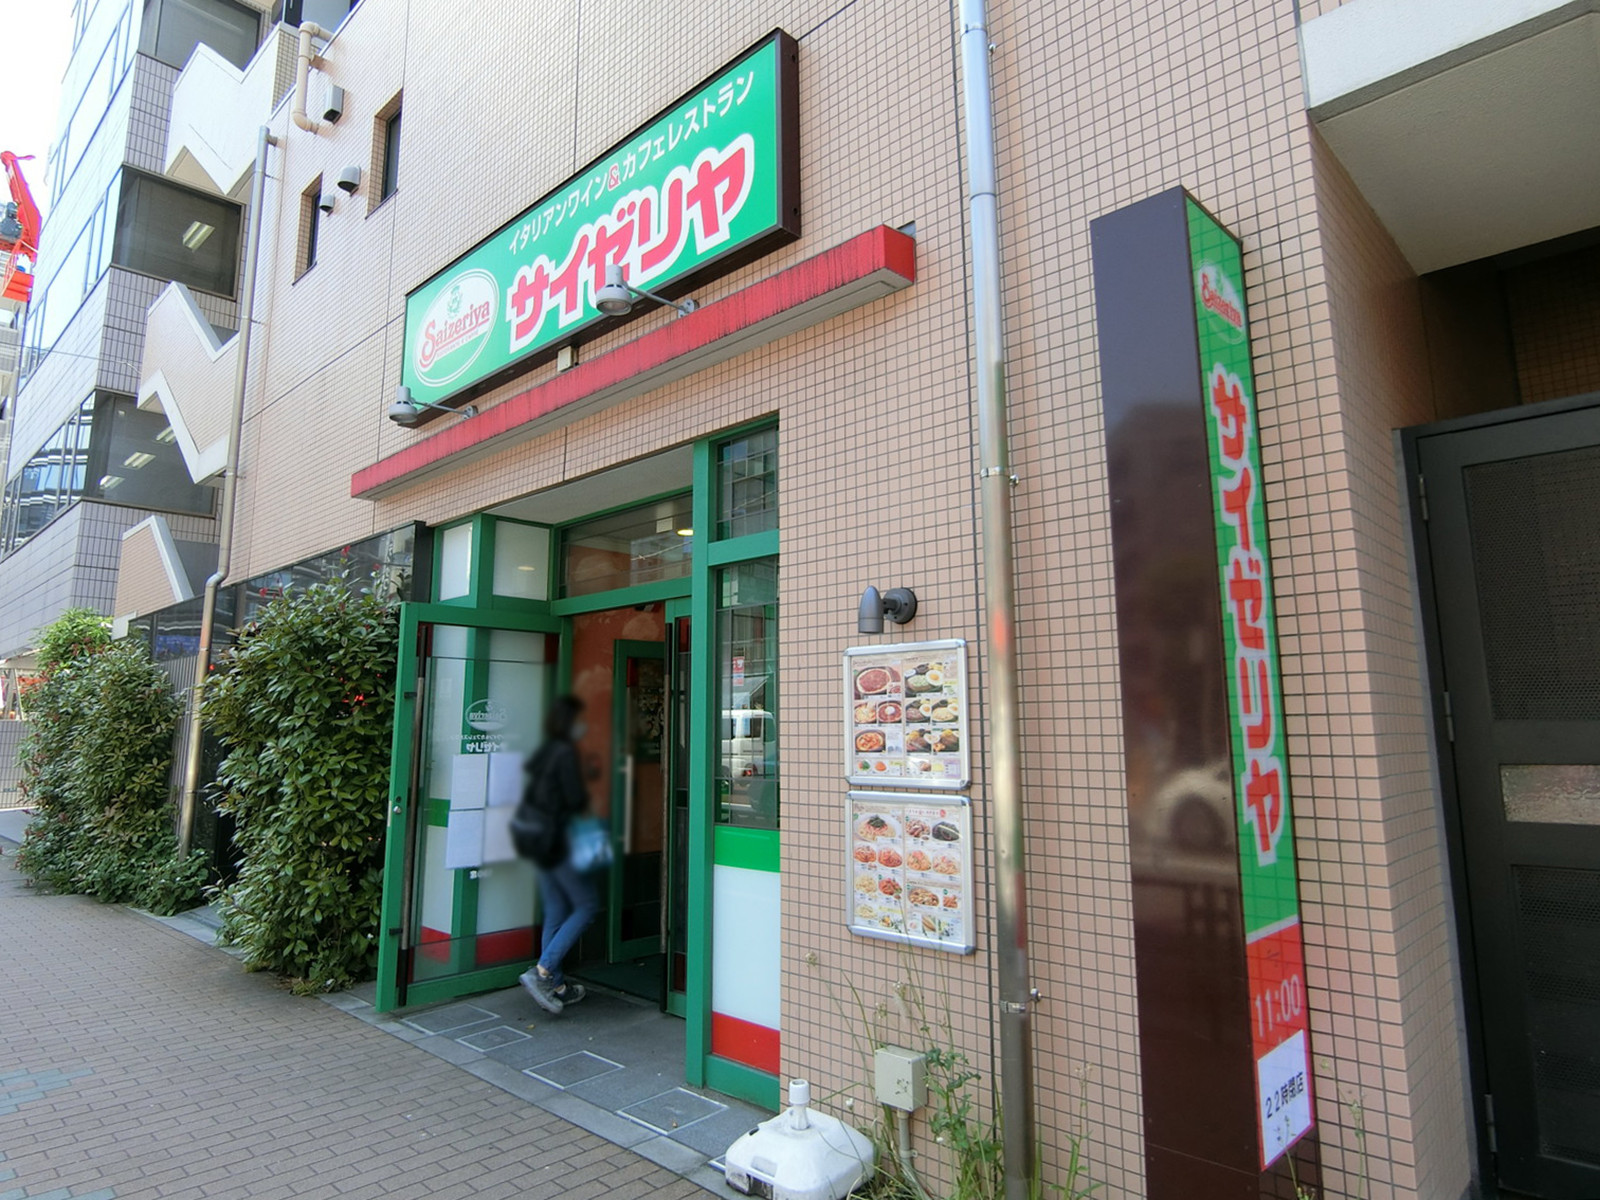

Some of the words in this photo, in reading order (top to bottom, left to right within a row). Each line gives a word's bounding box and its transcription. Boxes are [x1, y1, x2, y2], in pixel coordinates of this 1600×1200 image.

[507, 134, 754, 353] サイゼリヤ
[419, 301, 490, 368] Saizeriya
[1208, 362, 1284, 867] サイゼリヤ
[1255, 974, 1301, 1038] 11:00
